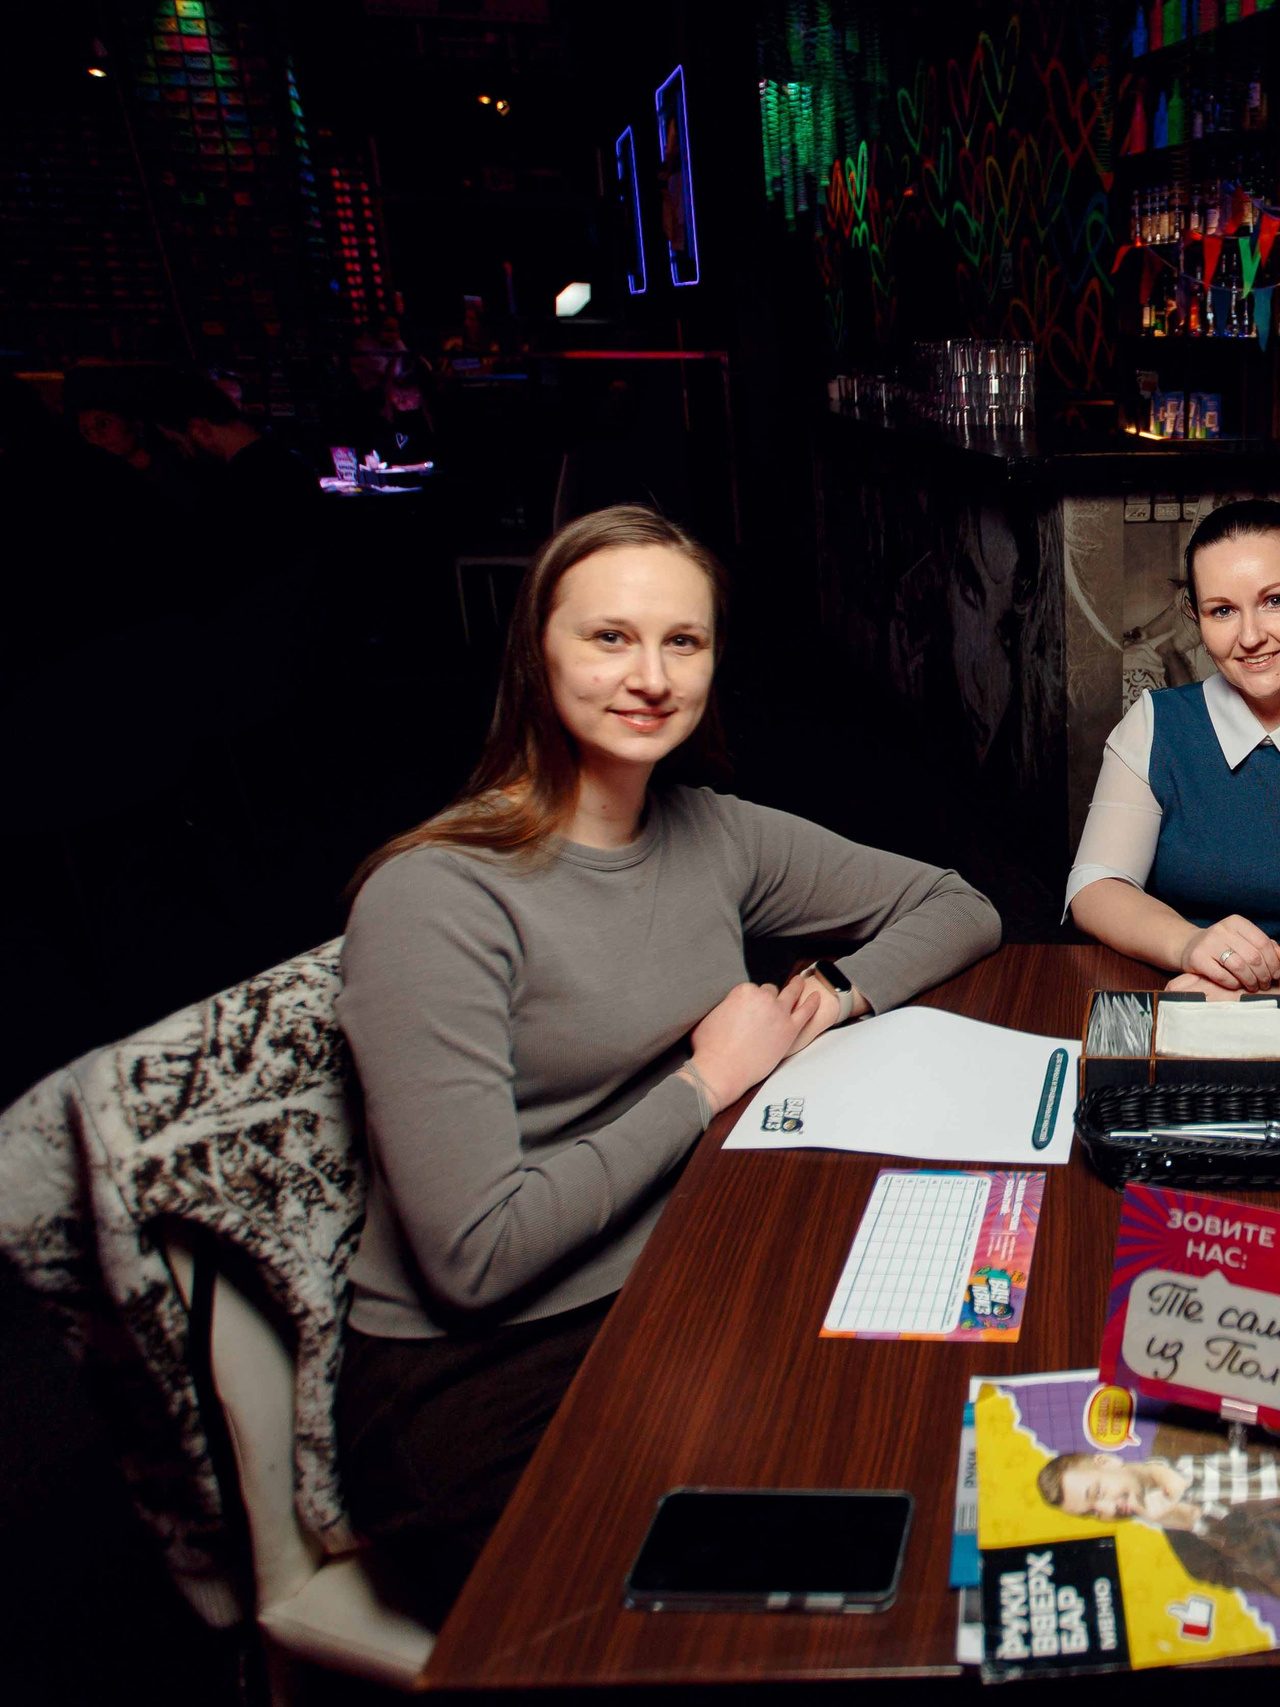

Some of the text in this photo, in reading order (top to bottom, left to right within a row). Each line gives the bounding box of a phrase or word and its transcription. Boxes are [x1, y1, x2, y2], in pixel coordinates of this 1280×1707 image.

[765, 1105, 783, 1129] КВИЗ
[783, 1098, 804, 1119] ВАУ
[1167, 1208, 1276, 1248] ЗОВИТЕ
[1186, 1241, 1248, 1270] НАС:
[972, 1285, 991, 1315] КВИЗ
[990, 1278, 1009, 1305] ВАУ
[1148, 1281, 1204, 1324] Те
[1145, 1335, 1184, 1381] из
[996, 1570, 1029, 1660] РУКИ
[1026, 1550, 1060, 1657] ВВЕРХ
[1057, 1585, 1089, 1654] БАР
[1094, 1576, 1118, 1650] МЕНЮ
